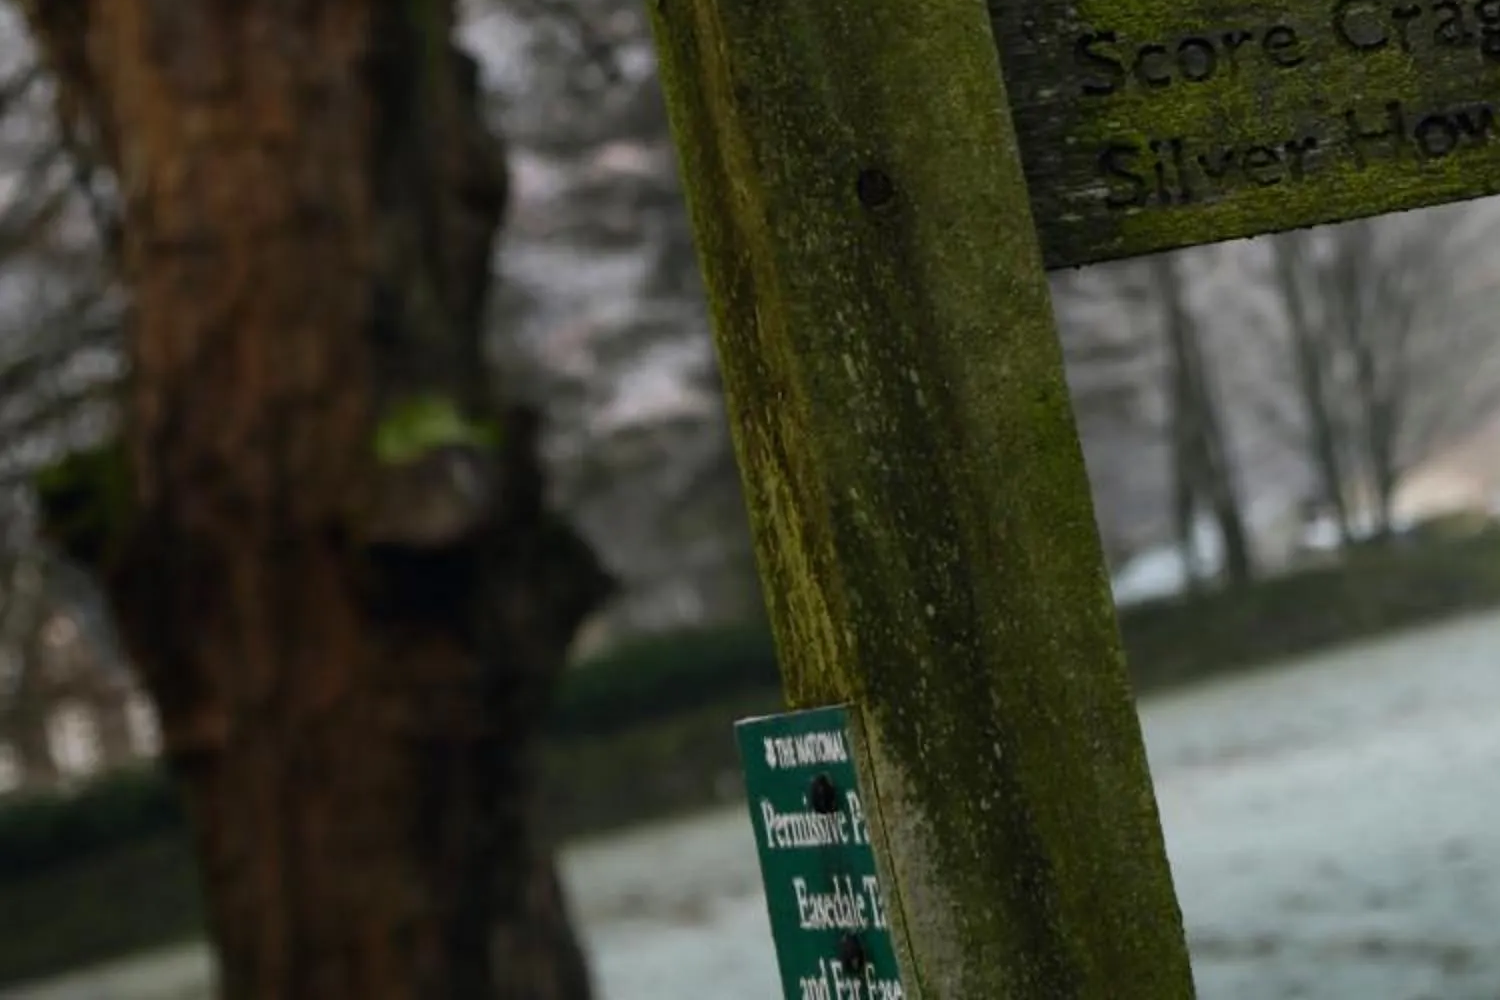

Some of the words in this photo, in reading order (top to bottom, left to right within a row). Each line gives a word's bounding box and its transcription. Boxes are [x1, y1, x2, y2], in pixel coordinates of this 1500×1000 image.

[1075, 24, 1306, 96] Score
[1099, 134, 1321, 208] Silver
[775, 737, 800, 768] THE
[796, 730, 847, 766] NATIONAL
[761, 796, 848, 848] Permissive
[793, 876, 868, 929] Easedale
[799, 956, 830, 1000] and
